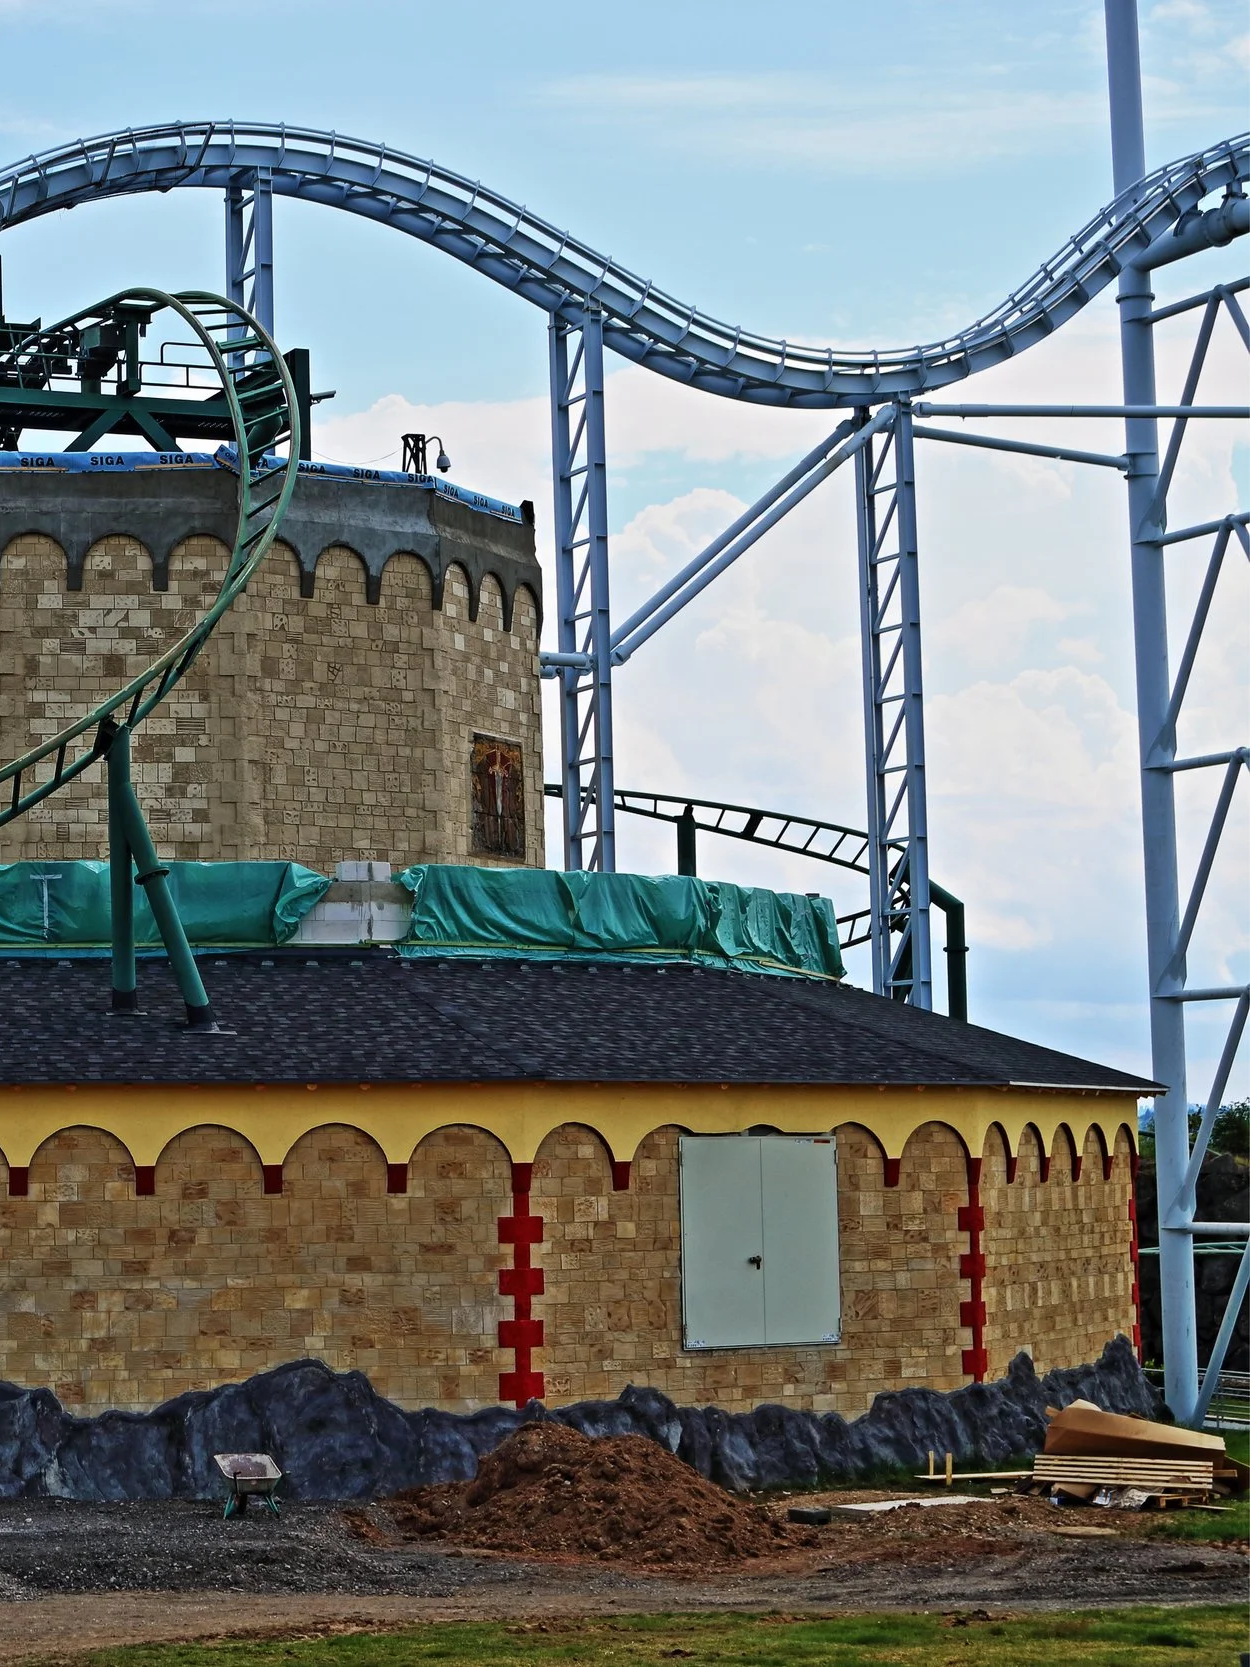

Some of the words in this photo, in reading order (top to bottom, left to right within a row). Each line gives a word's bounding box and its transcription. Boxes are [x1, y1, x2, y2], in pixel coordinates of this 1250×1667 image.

[20, 457, 55, 467] SIGA
[90, 456, 125, 466] SIGA
[159, 454, 194, 464] SIGA
[298, 463, 326, 474] SIGA
[352, 468, 381, 480] SIGA
[407, 473, 434, 483] SIGA
[443, 484, 459, 498] SIGA
[473, 495, 489, 508] SIGA
